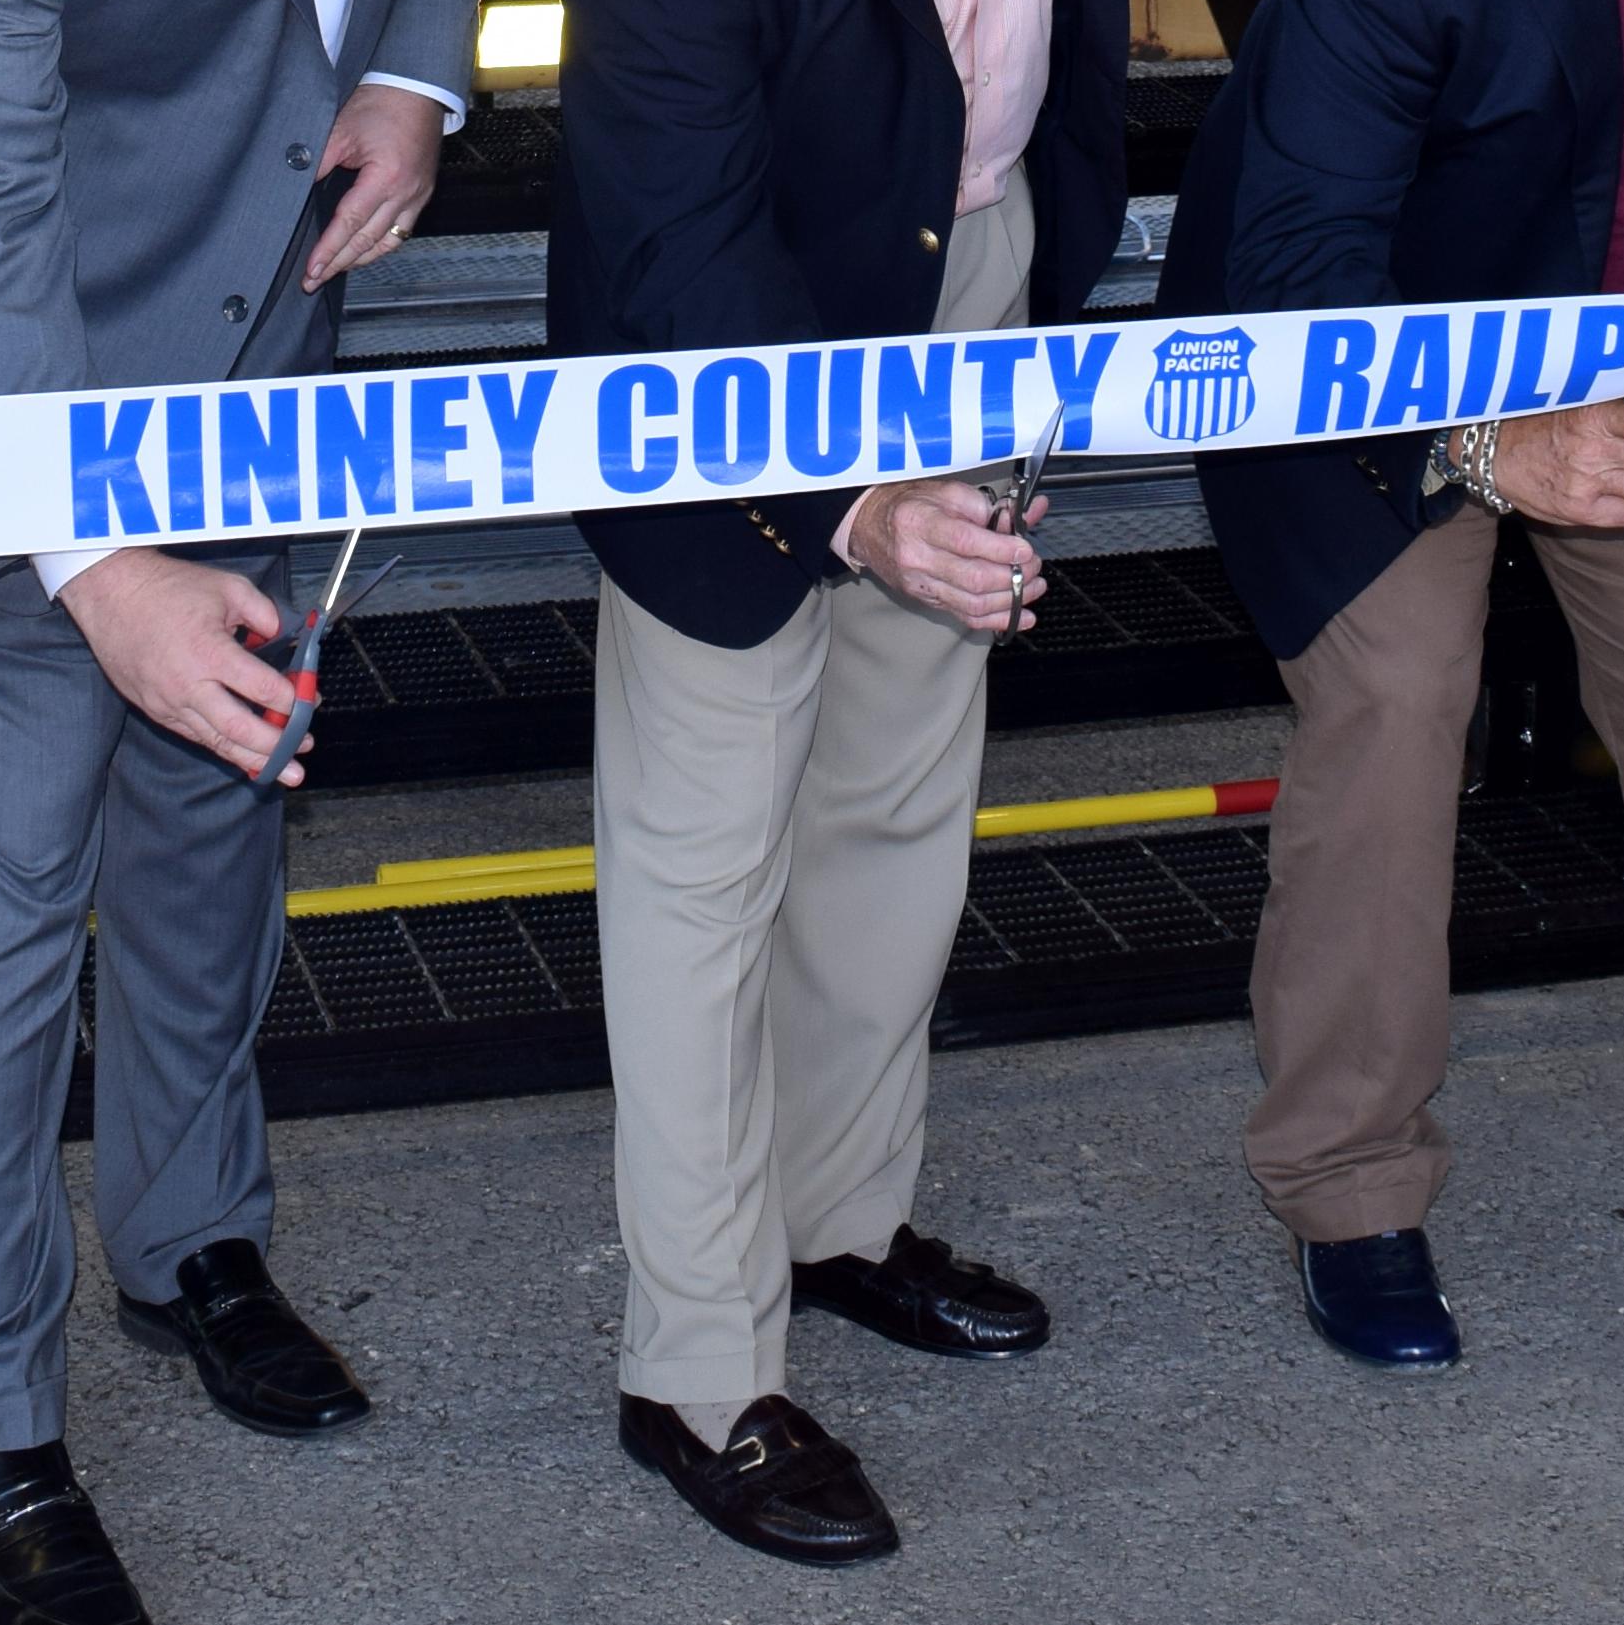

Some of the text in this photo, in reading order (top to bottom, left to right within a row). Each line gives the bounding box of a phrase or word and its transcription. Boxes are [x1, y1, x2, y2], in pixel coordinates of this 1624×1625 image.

[1170, 339, 1239, 356] UNION
[1163, 354, 1242, 373] PACIFIC
[67, 331, 1120, 540] KINNEY COUNTY
